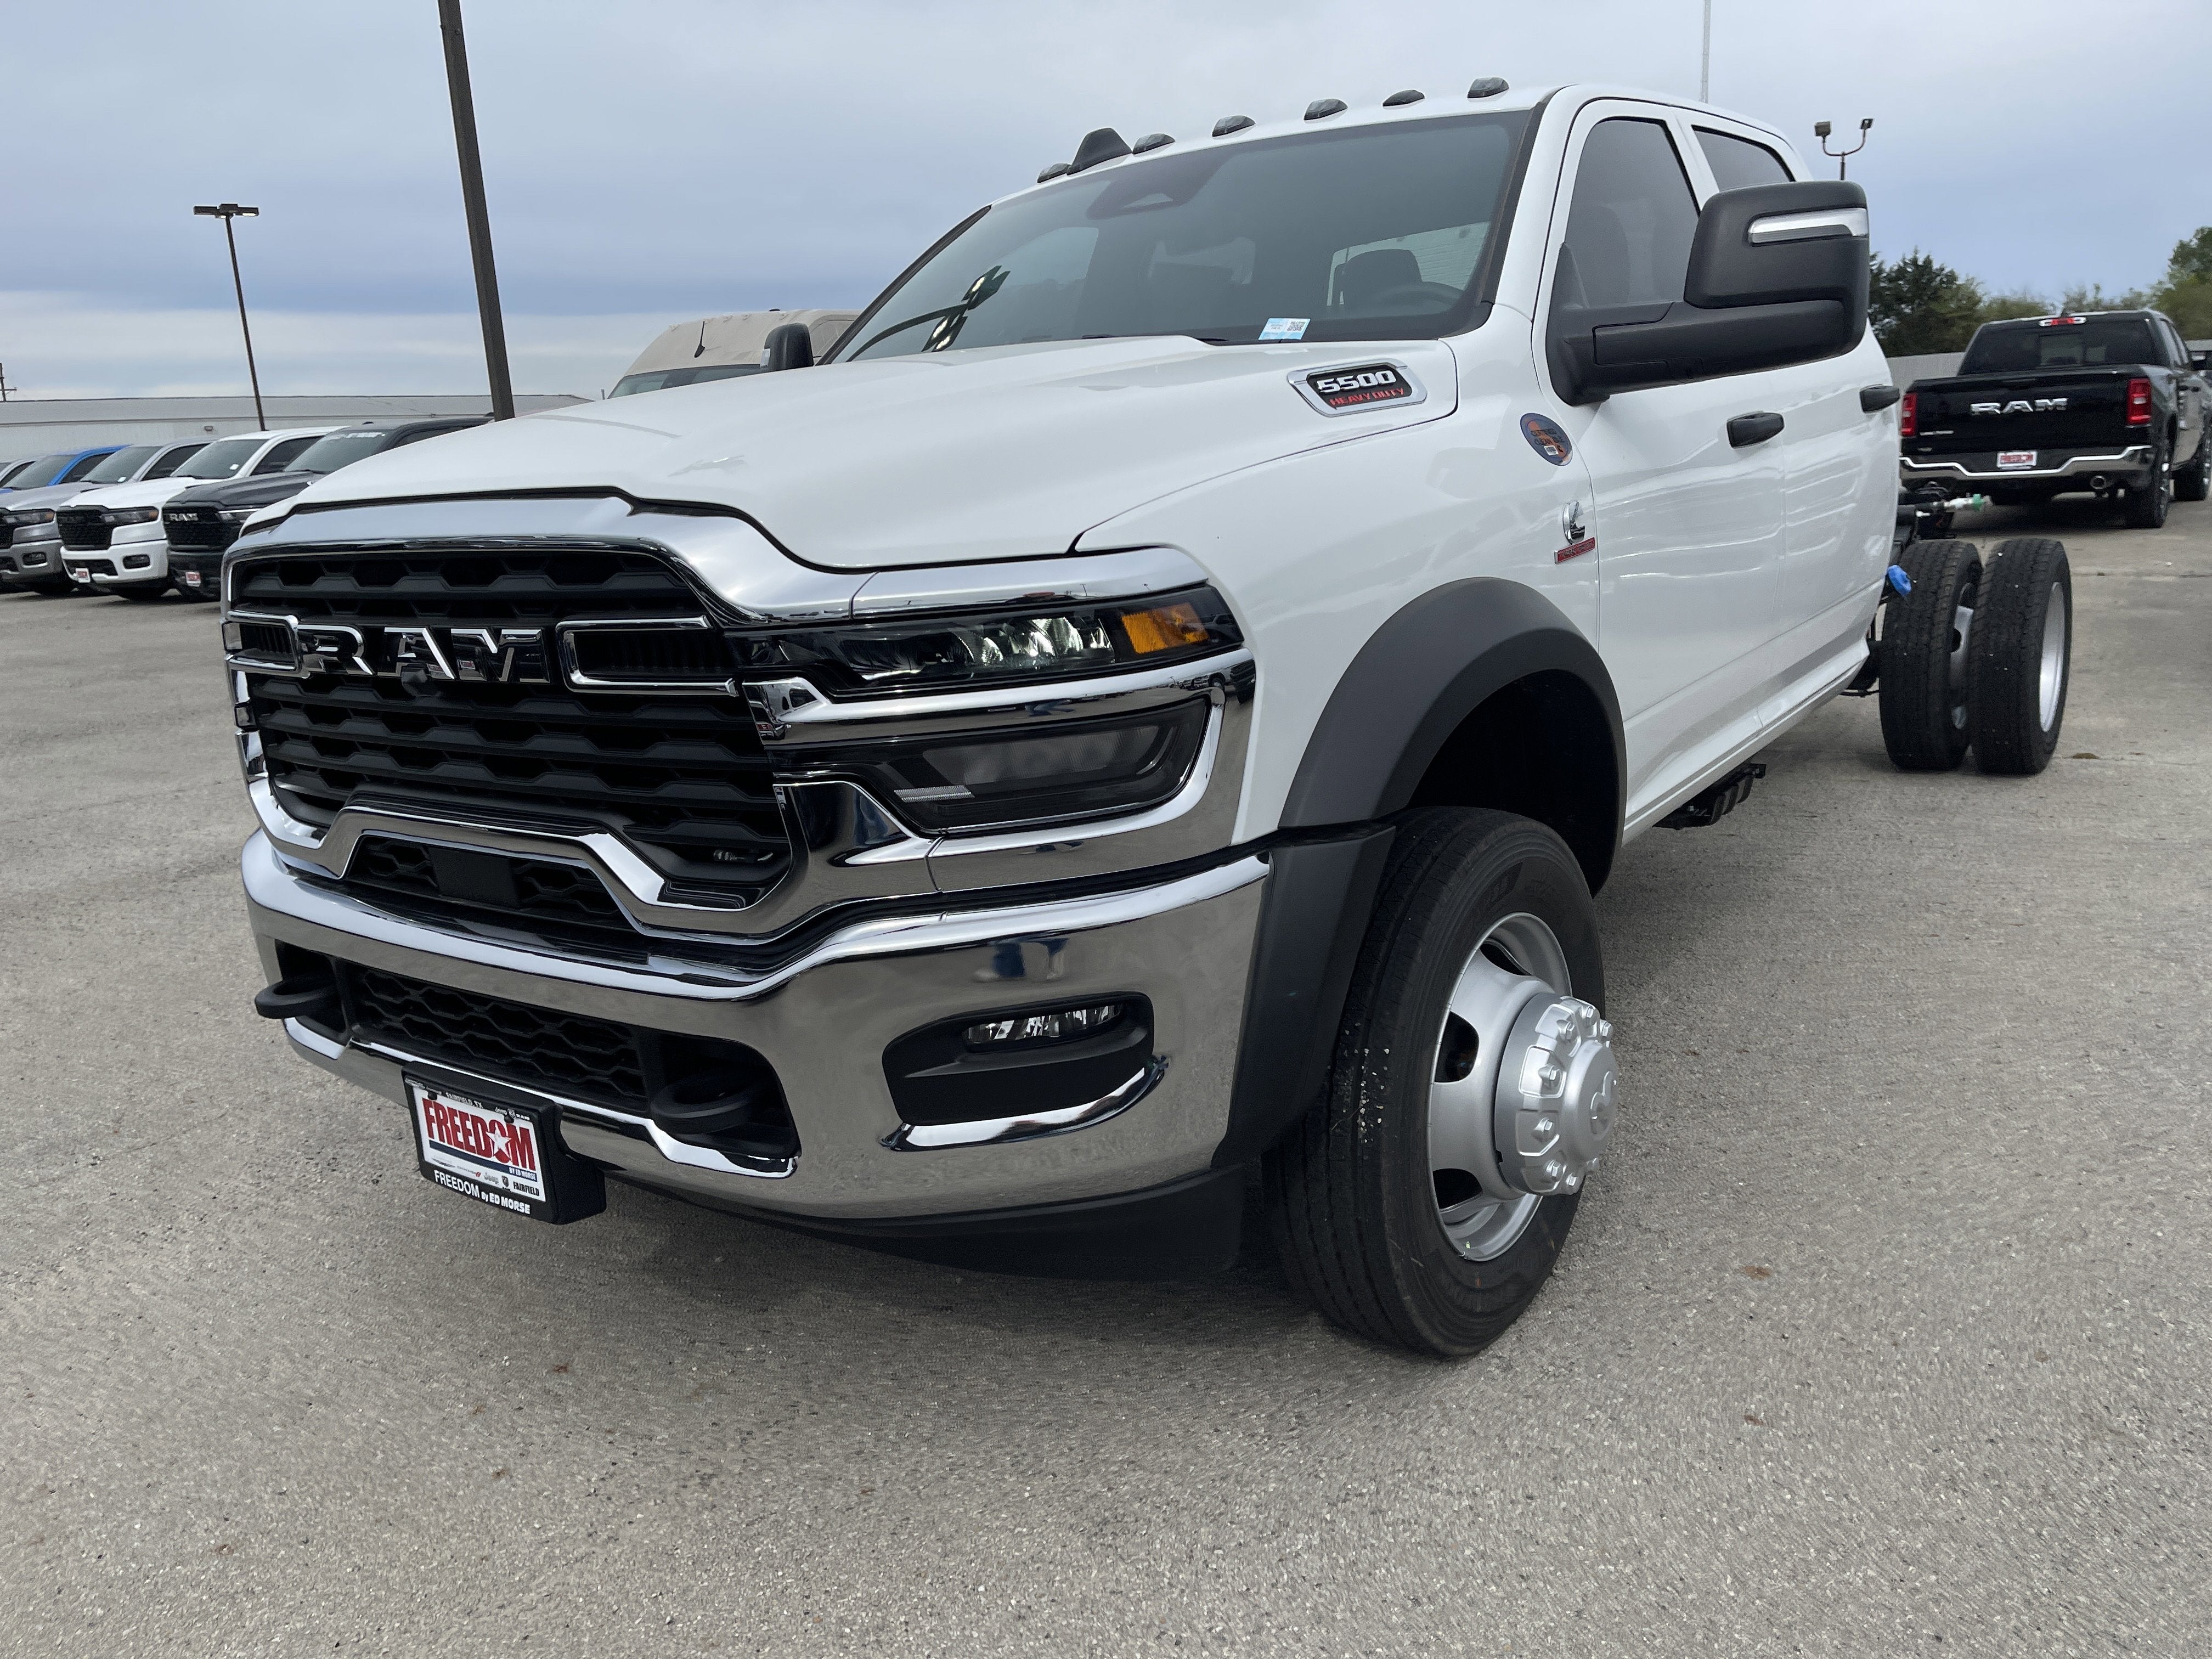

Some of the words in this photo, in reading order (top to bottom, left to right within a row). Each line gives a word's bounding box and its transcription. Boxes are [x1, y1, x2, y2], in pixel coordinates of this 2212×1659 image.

[1317, 370, 1397, 393] 5500
[1329, 393, 1370, 405] HEAVY
[1372, 387, 1404, 399] DUTY
[1970, 398, 2068, 415] RAM
[297, 623, 551, 684] RAM
[421, 1097, 537, 1171] FREEDOM
[434, 1170, 480, 1198] FREEDOM
[489, 1193, 500, 1205] ED
[501, 1196, 531, 1215] MORSE
[513, 1181, 540, 1197] FAIRFIELD
